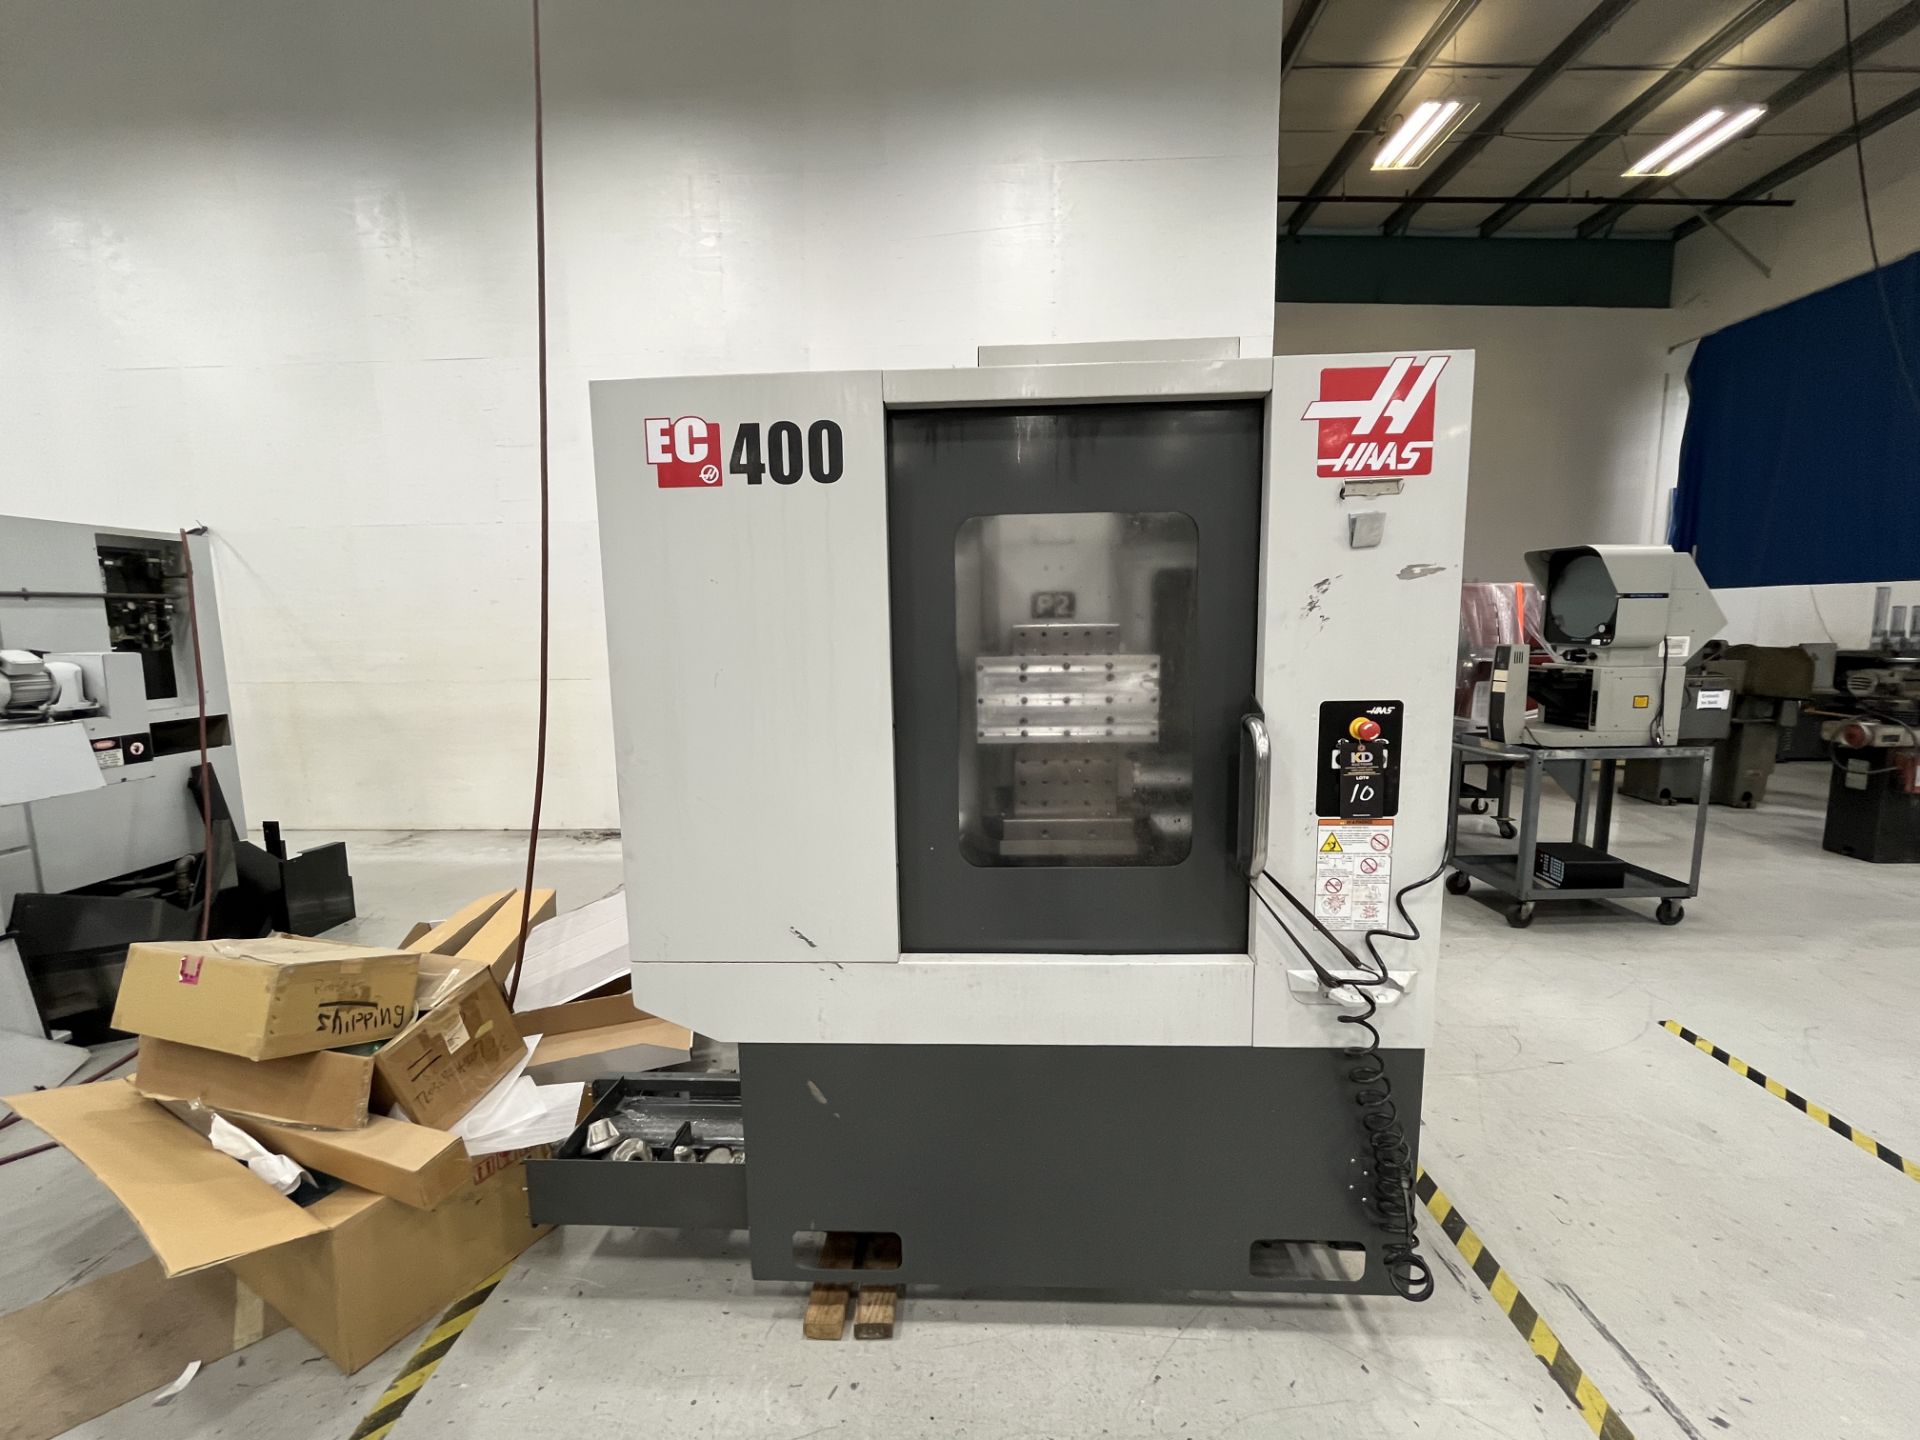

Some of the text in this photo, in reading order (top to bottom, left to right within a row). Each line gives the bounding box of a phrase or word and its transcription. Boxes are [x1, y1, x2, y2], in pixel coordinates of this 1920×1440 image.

[644, 415, 844, 485] EC 400
[1318, 441, 1434, 472] HAAS
[1350, 752, 1374, 764] KD
[1350, 783, 1375, 804] 10
